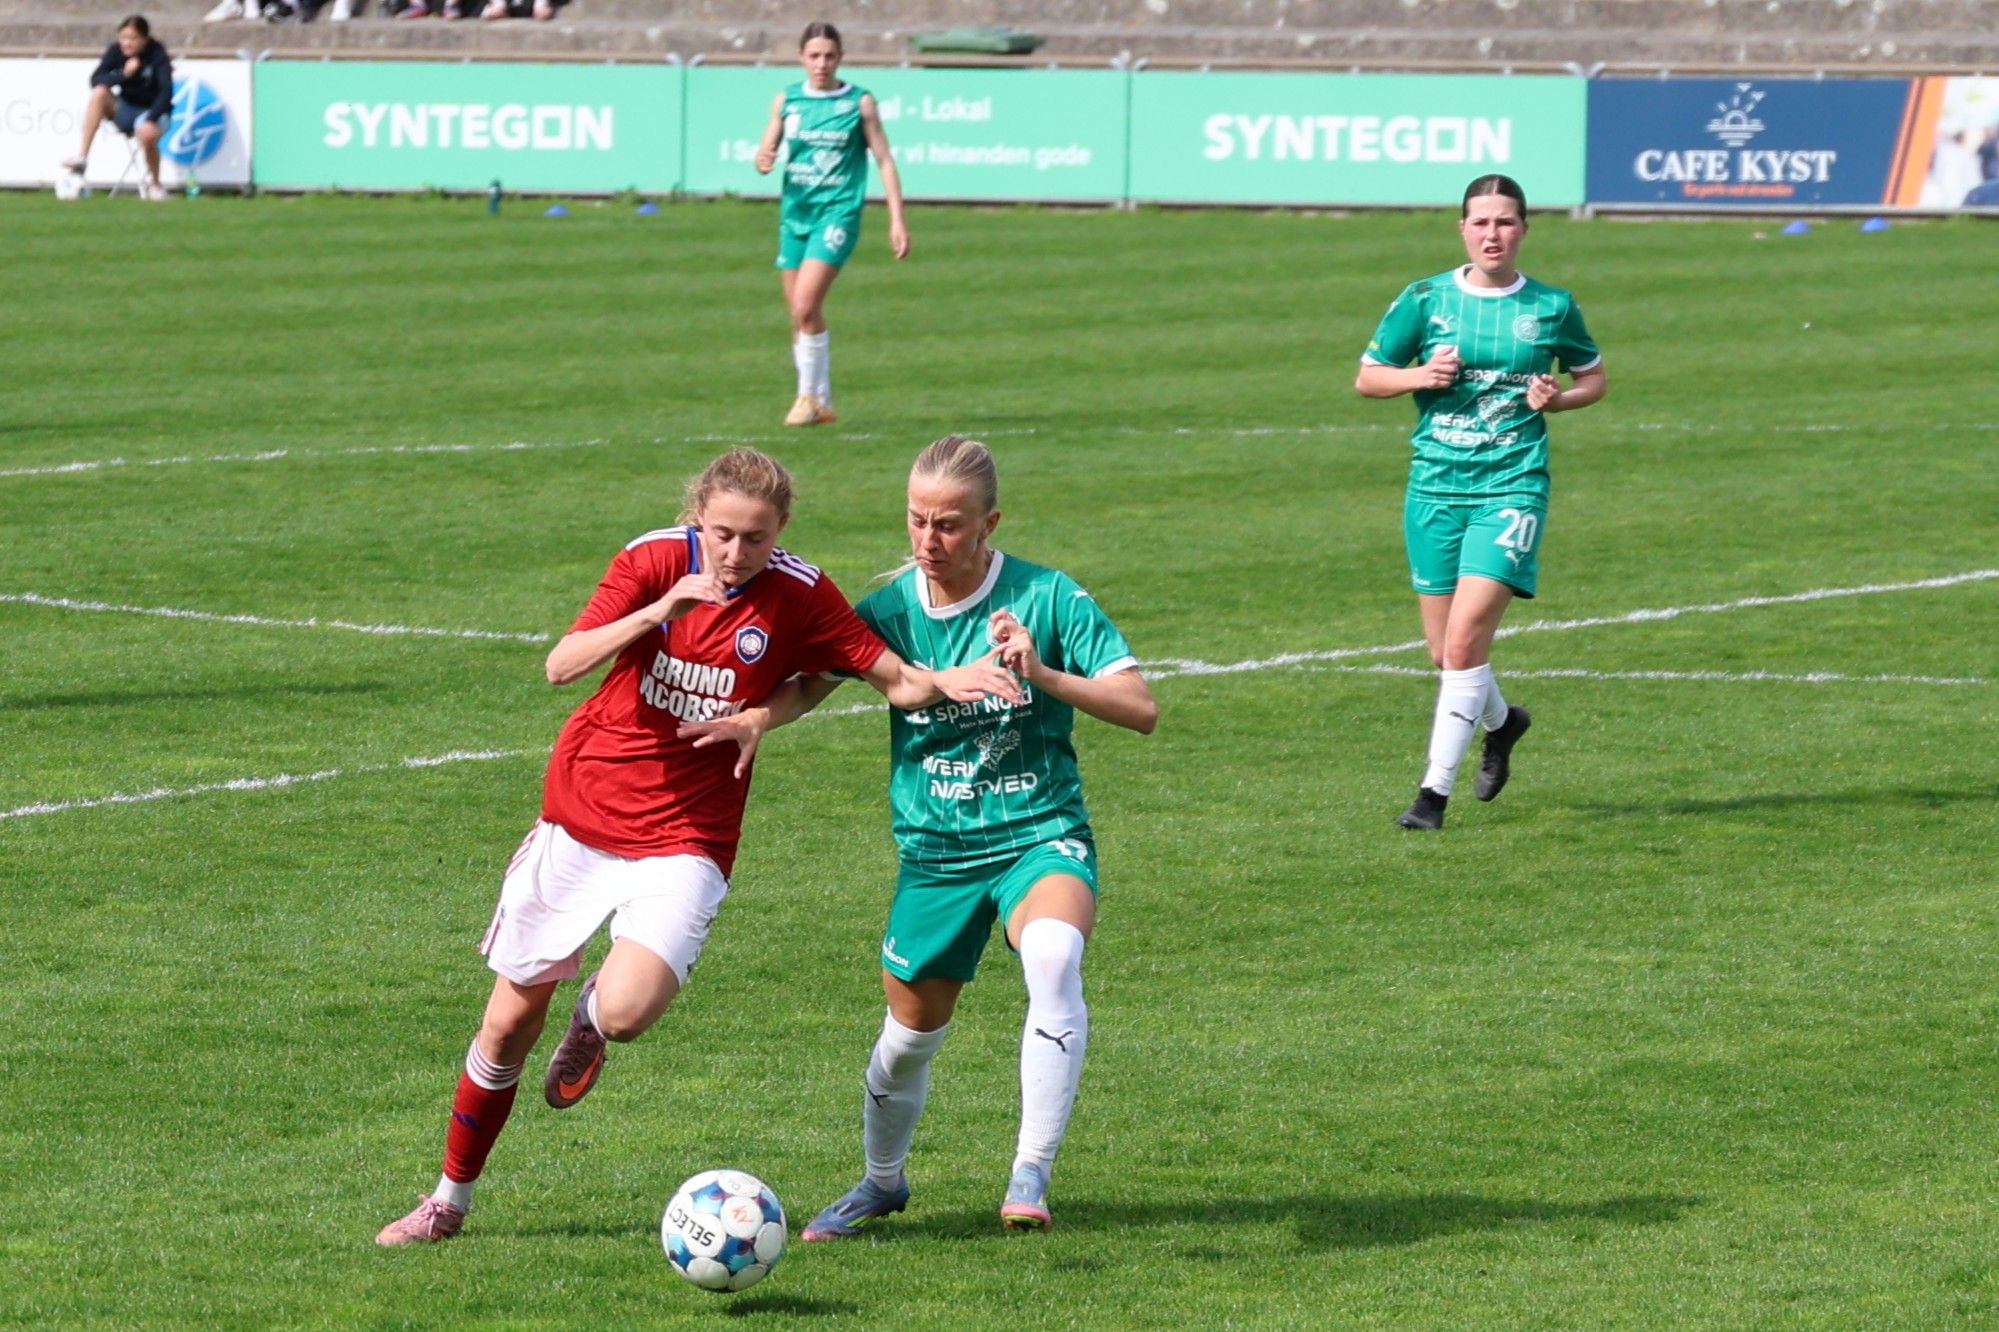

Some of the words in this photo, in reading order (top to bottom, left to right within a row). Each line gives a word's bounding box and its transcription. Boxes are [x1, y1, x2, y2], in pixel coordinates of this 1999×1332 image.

[323, 101, 614, 149] SYNTEGON
[922, 97, 991, 122] Lokal
[906, 142, 924, 162] vi
[927, 142, 1030, 164] hinanden
[1035, 143, 1092, 168] gode
[1203, 114, 1512, 162] SYNTEGON
[1634, 150, 1730, 182] CAFE
[1739, 150, 1837, 183] KYST
[1494, 508, 1538, 553] 20
[651, 649, 736, 699] BRUNO
[934, 701, 980, 724] spar
